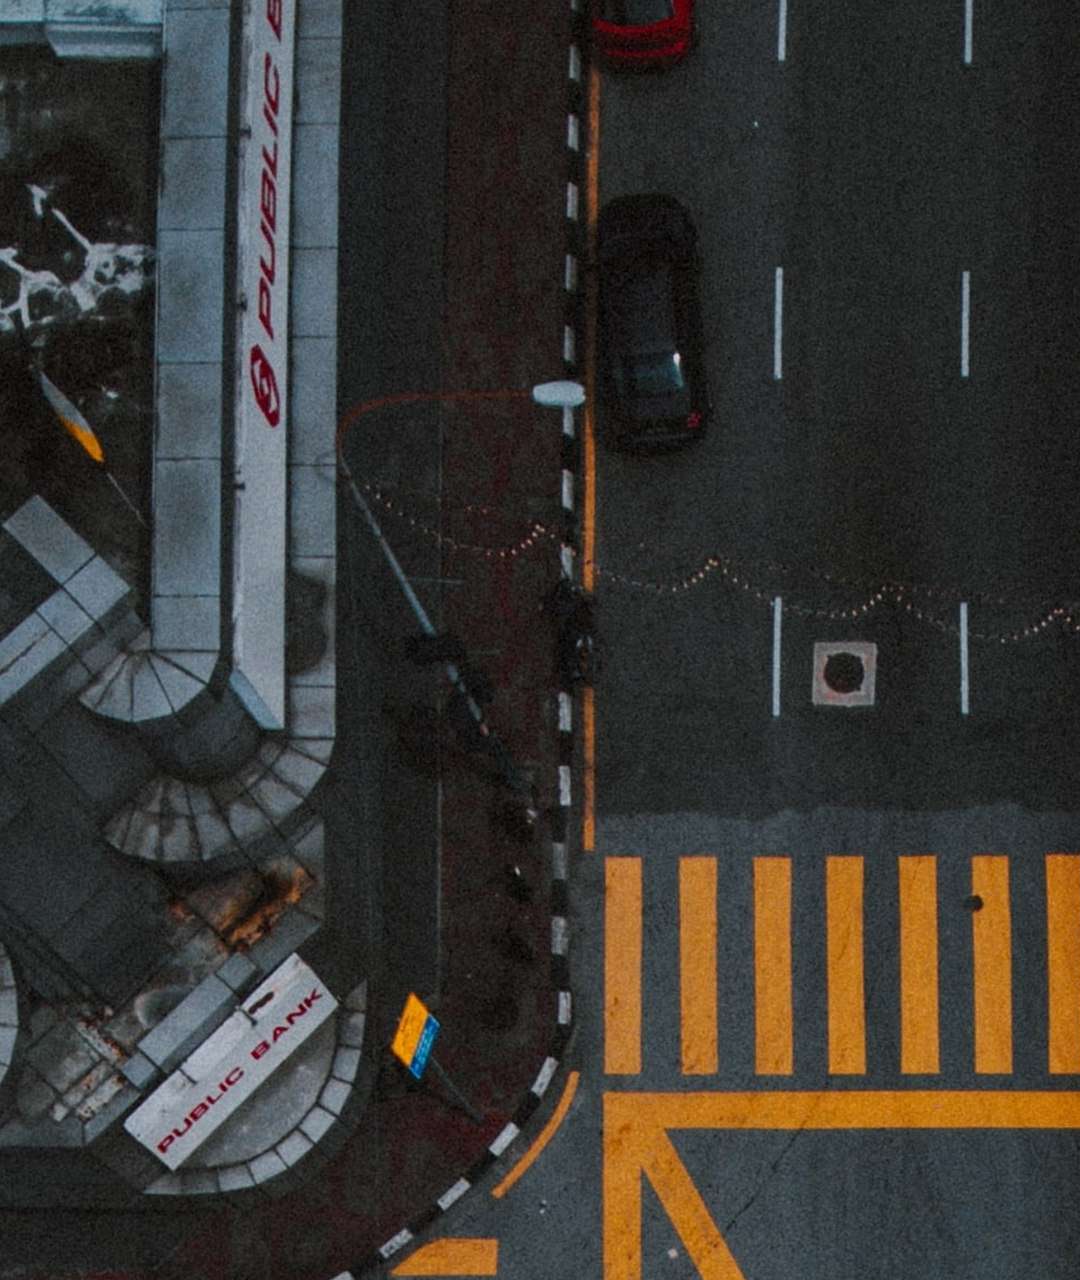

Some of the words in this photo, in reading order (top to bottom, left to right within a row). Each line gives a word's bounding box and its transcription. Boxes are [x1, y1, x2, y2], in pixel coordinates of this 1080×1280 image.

[258, 51, 280, 341] PUBLIC
[156, 1066, 245, 1154] PUBLIC
[250, 988, 323, 1061] BANK
